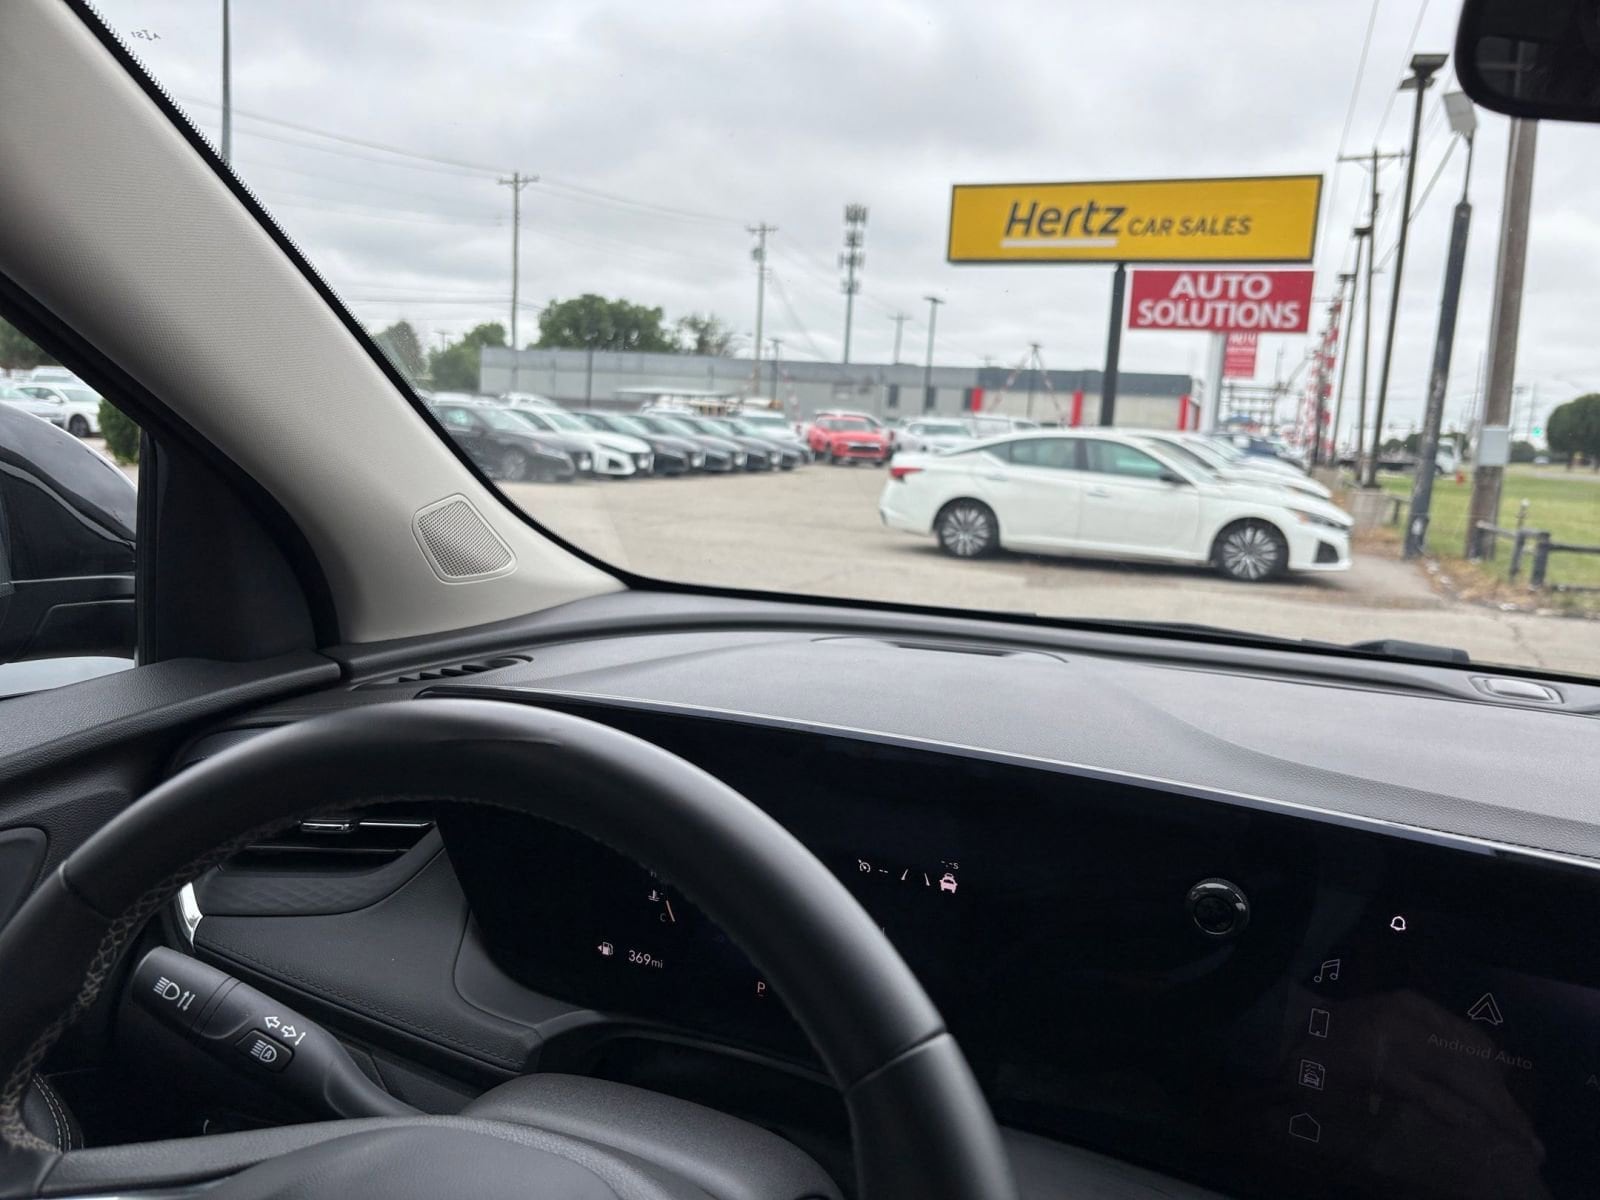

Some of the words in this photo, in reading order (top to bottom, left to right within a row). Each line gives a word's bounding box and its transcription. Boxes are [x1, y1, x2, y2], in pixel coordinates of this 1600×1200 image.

[1004, 199, 1127, 237] Hertz
[1129, 217, 1172, 237] CAR
[1177, 215, 1253, 236] SALES
[1170, 273, 1272, 300] AUTO
[1137, 299, 1300, 330] SOLUTIONS
[757, 980, 766, 993] P
[1427, 1033, 1491, 1059] Android
[1495, 1050, 1534, 1071] Auto
